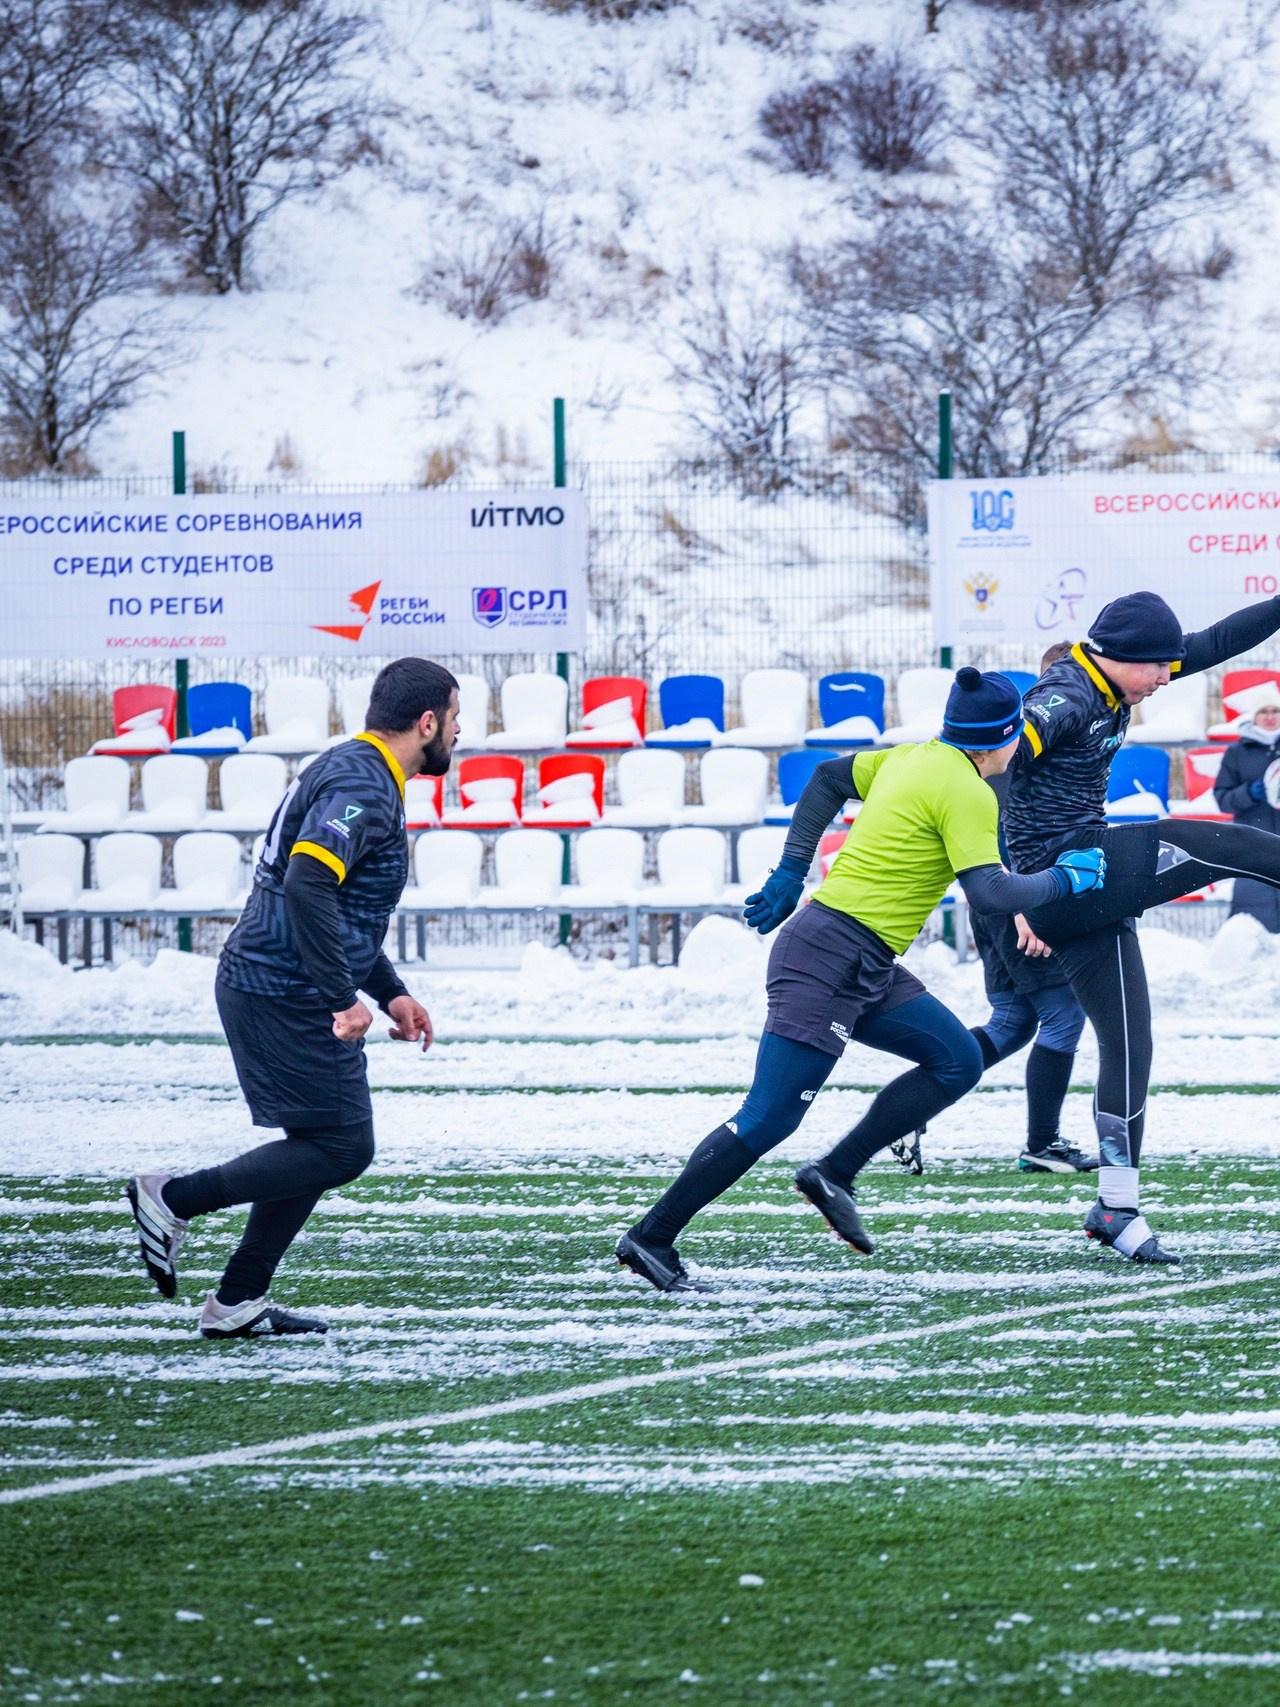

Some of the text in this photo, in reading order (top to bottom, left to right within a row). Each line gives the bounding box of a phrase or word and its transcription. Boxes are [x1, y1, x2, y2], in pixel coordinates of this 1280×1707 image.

[177, 512, 362, 532] СОРЕВНОВАНИЯ
[1189, 533, 1268, 555] СРЕДИ
[53, 555, 274, 577] СРЕДИ СТУДЕНТОВ
[1244, 575, 1278, 594] ПО
[109, 597, 223, 615] ПО РЕГБИ
[380, 597, 429, 609] РЕГБИ
[509, 590, 567, 611] СРЛ
[381, 612, 446, 625] РОССИИ
[106, 636, 226, 648] КИСЛОВОДСК 2023
